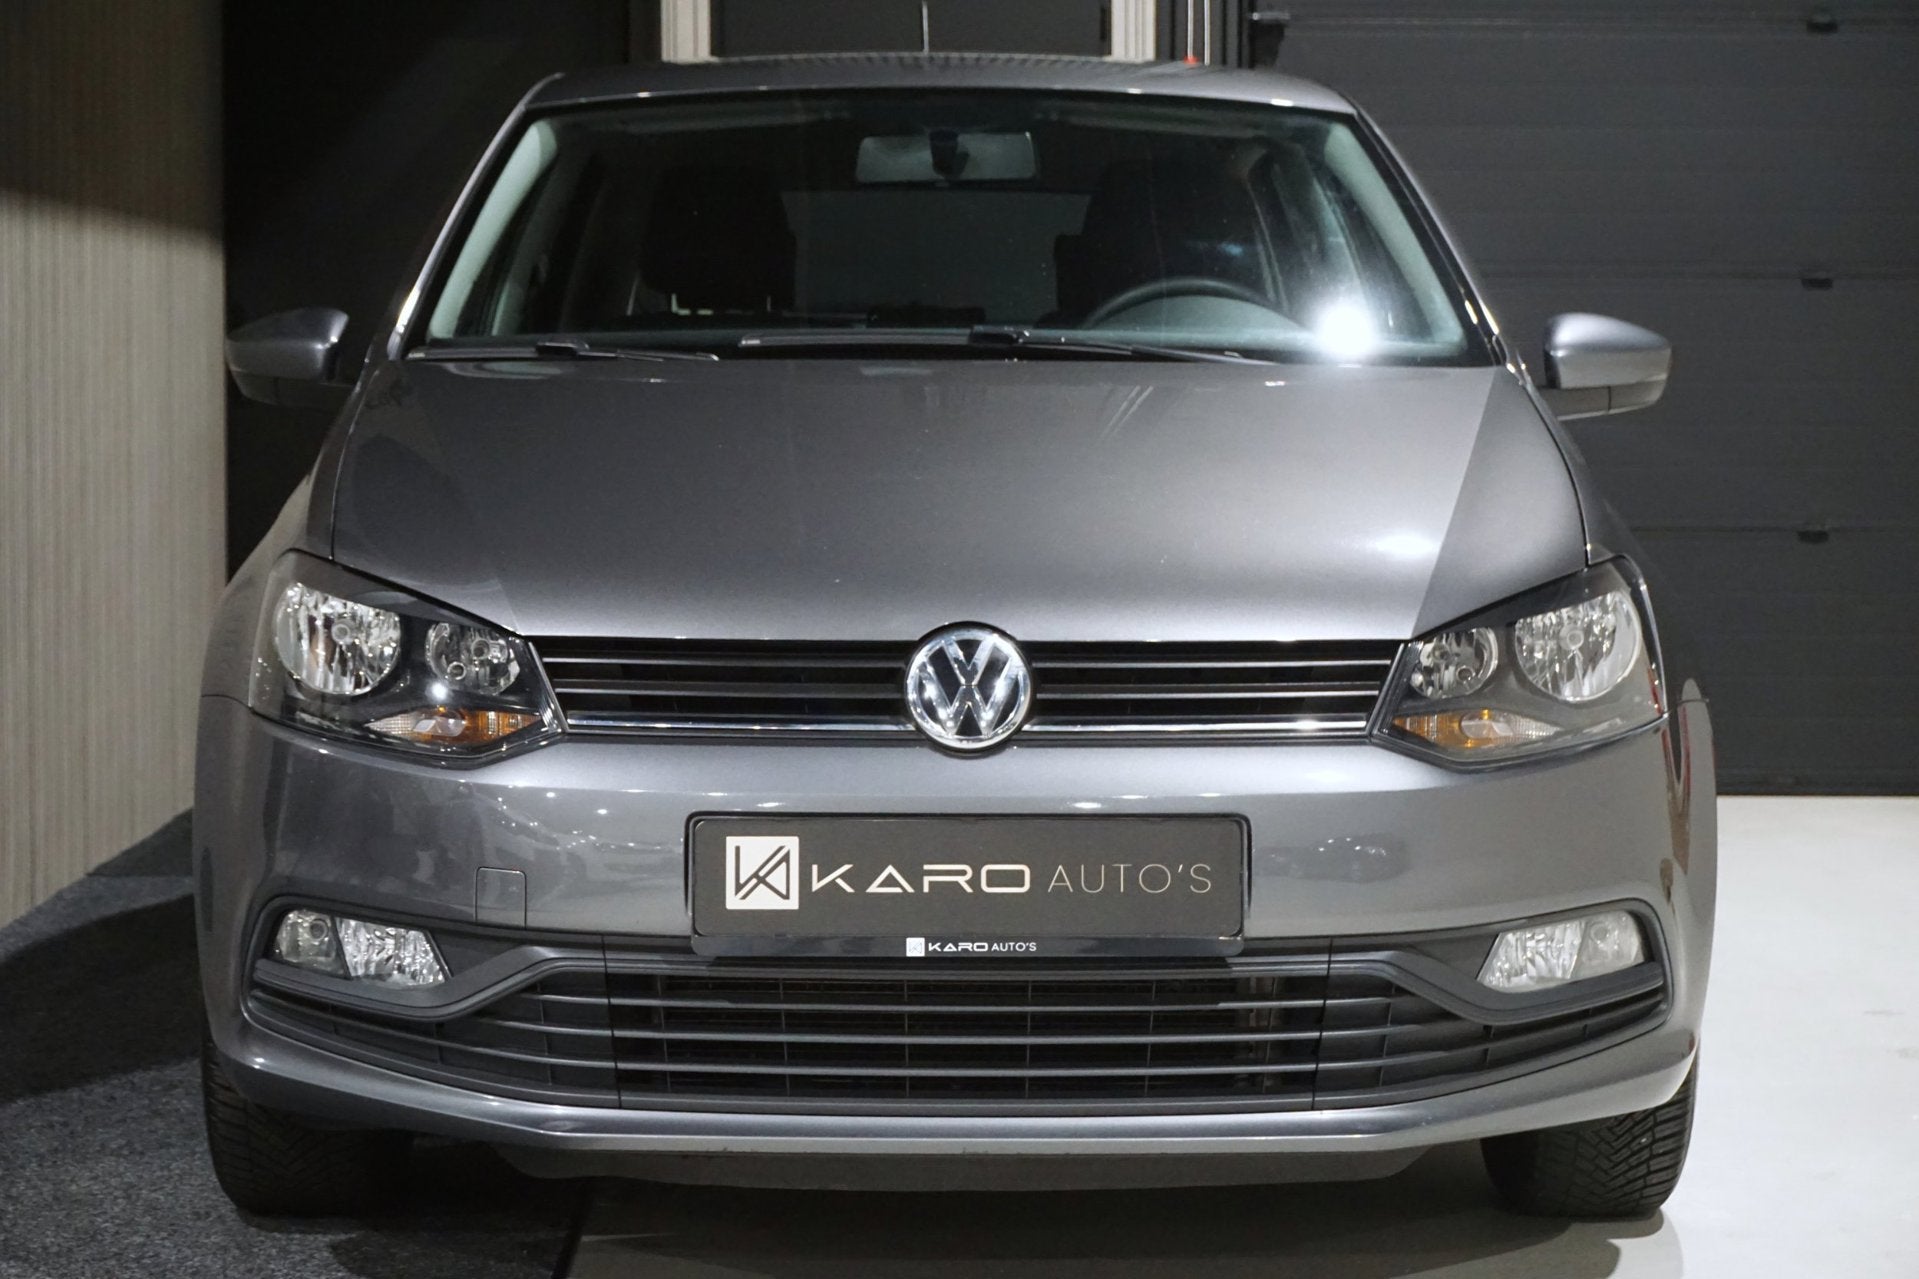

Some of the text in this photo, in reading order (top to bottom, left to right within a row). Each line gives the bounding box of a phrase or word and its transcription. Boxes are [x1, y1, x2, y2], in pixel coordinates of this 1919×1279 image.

[811, 863, 1032, 894] KARO
[1047, 863, 1213, 894] AUTO'S
[927, 941, 989, 953] KARO
[990, 941, 1038, 953] AUTO'S
